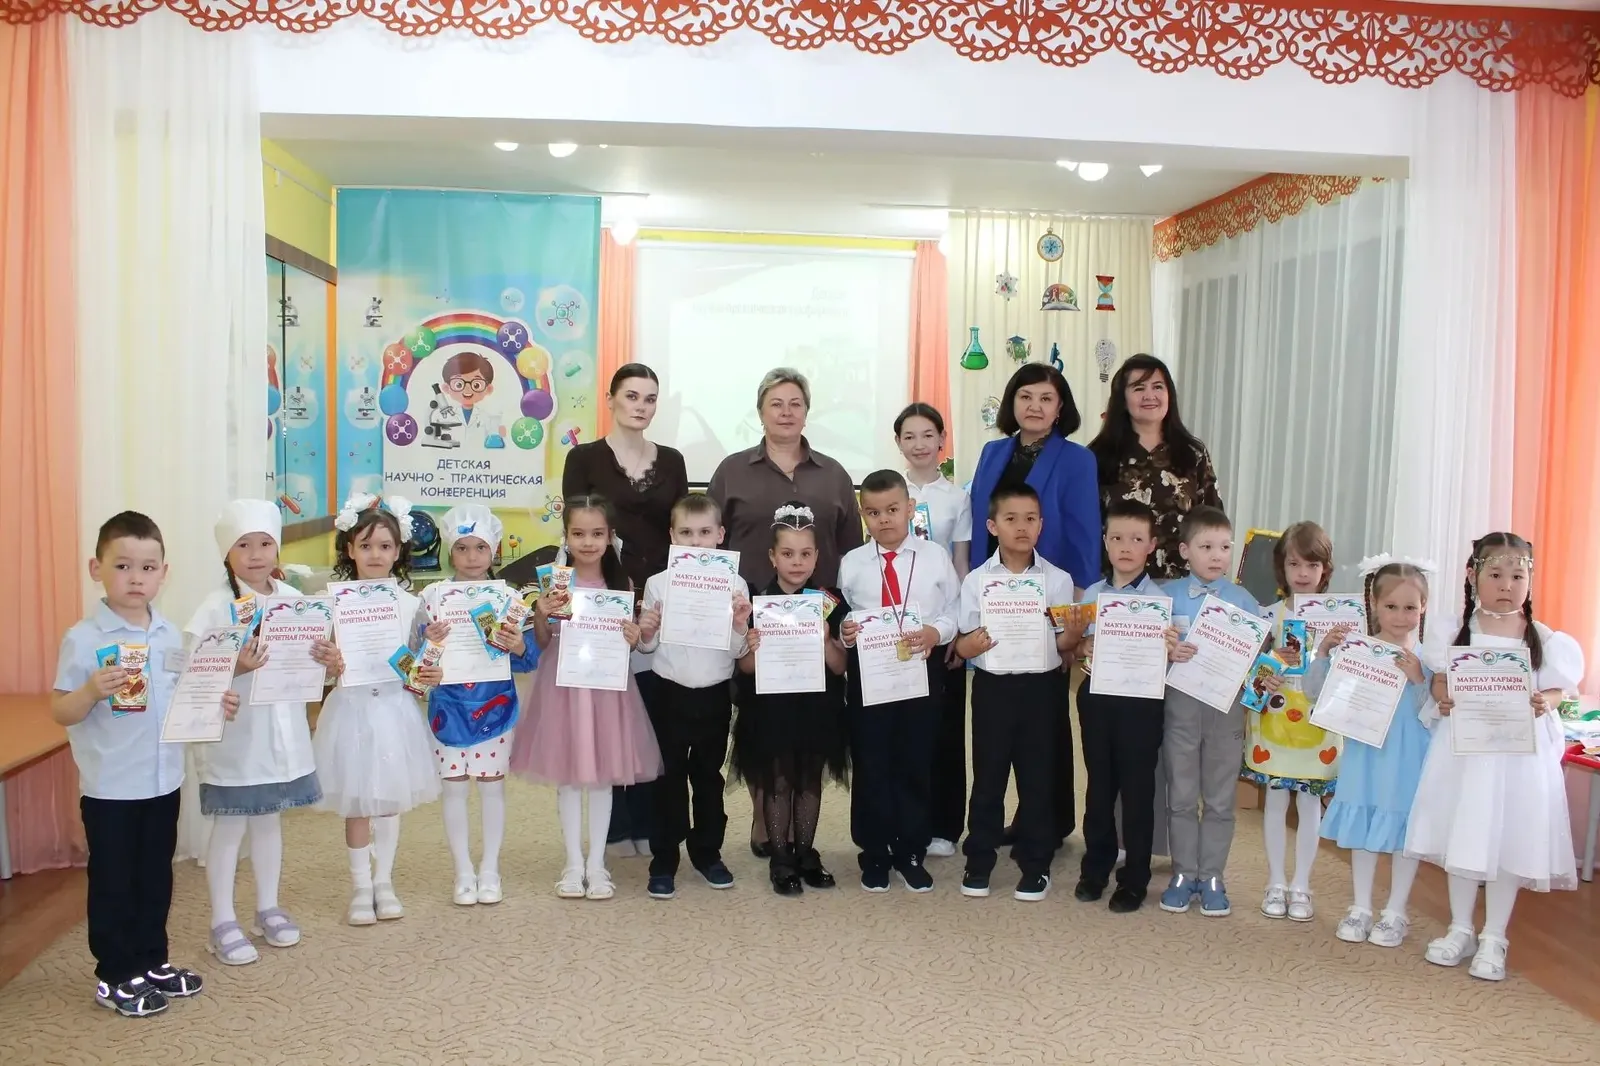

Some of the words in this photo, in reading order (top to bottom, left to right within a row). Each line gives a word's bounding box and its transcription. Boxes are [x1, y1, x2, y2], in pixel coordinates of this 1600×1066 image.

[437, 459, 491, 470] ДЕТСКАЯ
[385, 472, 434, 482] НАУЧНО
[451, 473, 543, 485] ПРАКТИЧЕСКАЯ
[420, 487, 506, 499] КОНФЕРЕНЦИЯ
[703, 584, 731, 592] ГРАМОТА
[1135, 631, 1164, 639] ГРАМОТА
[1225, 642, 1250, 659] ГРАМОТА
[1336, 663, 1370, 679] ПОЧЕТНАЯ
[1369, 674, 1398, 689] ГРАМОТА
